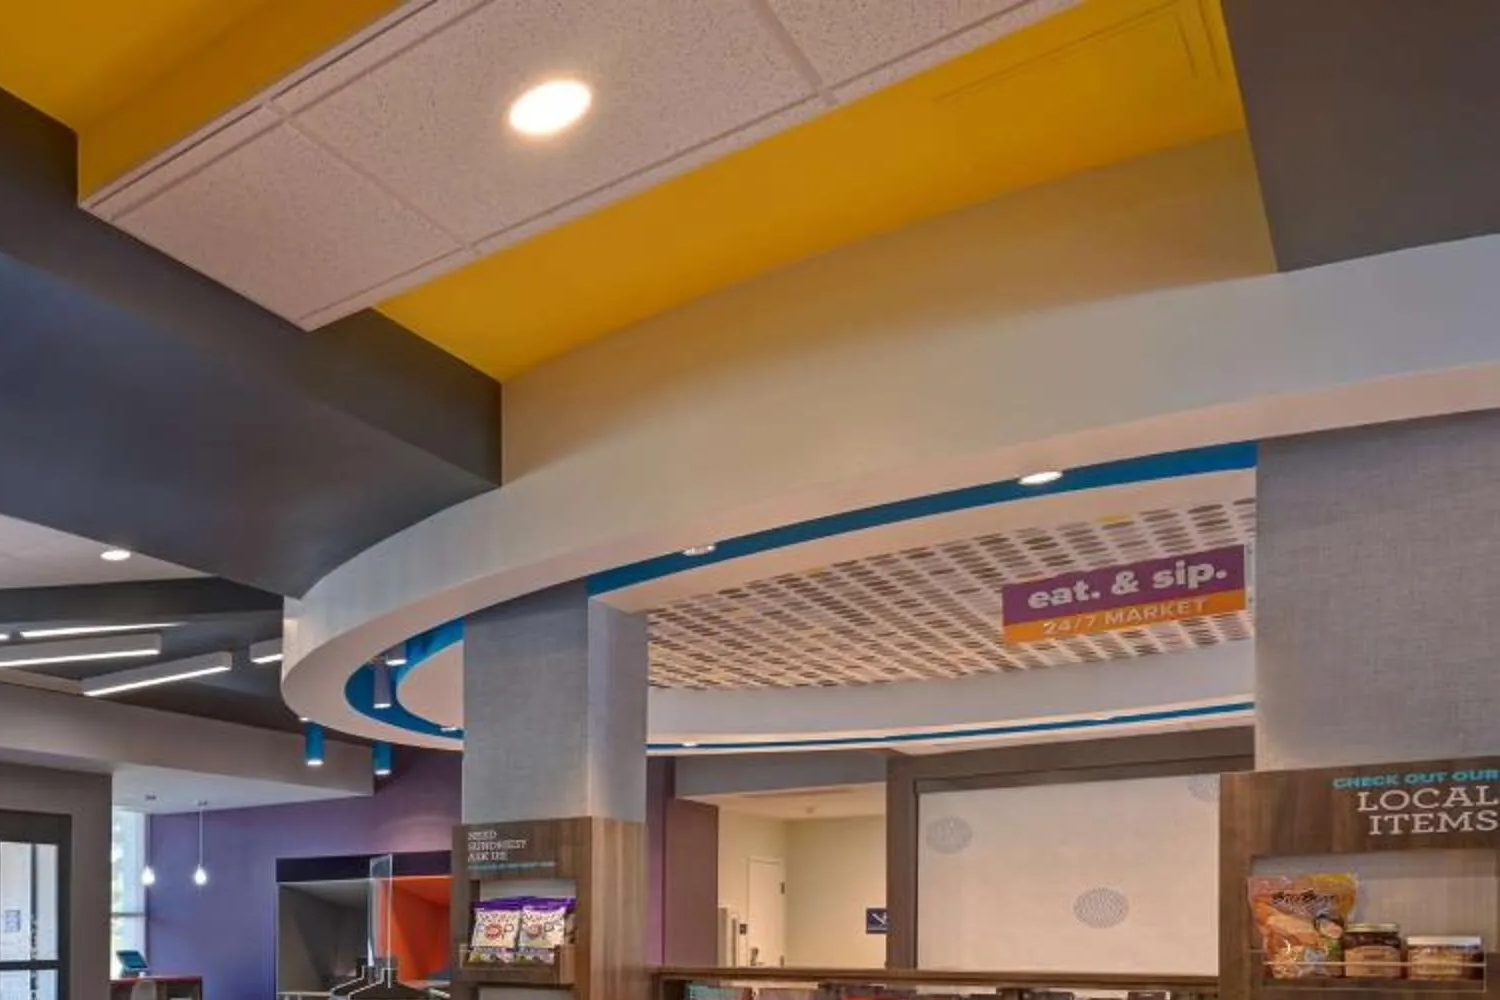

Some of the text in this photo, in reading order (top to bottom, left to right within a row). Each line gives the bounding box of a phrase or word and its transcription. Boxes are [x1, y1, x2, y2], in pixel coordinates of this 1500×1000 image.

[1027, 560, 1228, 609] eat. & sip.
[1043, 599, 1208, 635] 24/7 MARKET
[1333, 769, 1500, 789] CHECK OUT OUR
[1356, 785, 1499, 812] LOCAL
[1368, 809, 1499, 836] ITEMS
